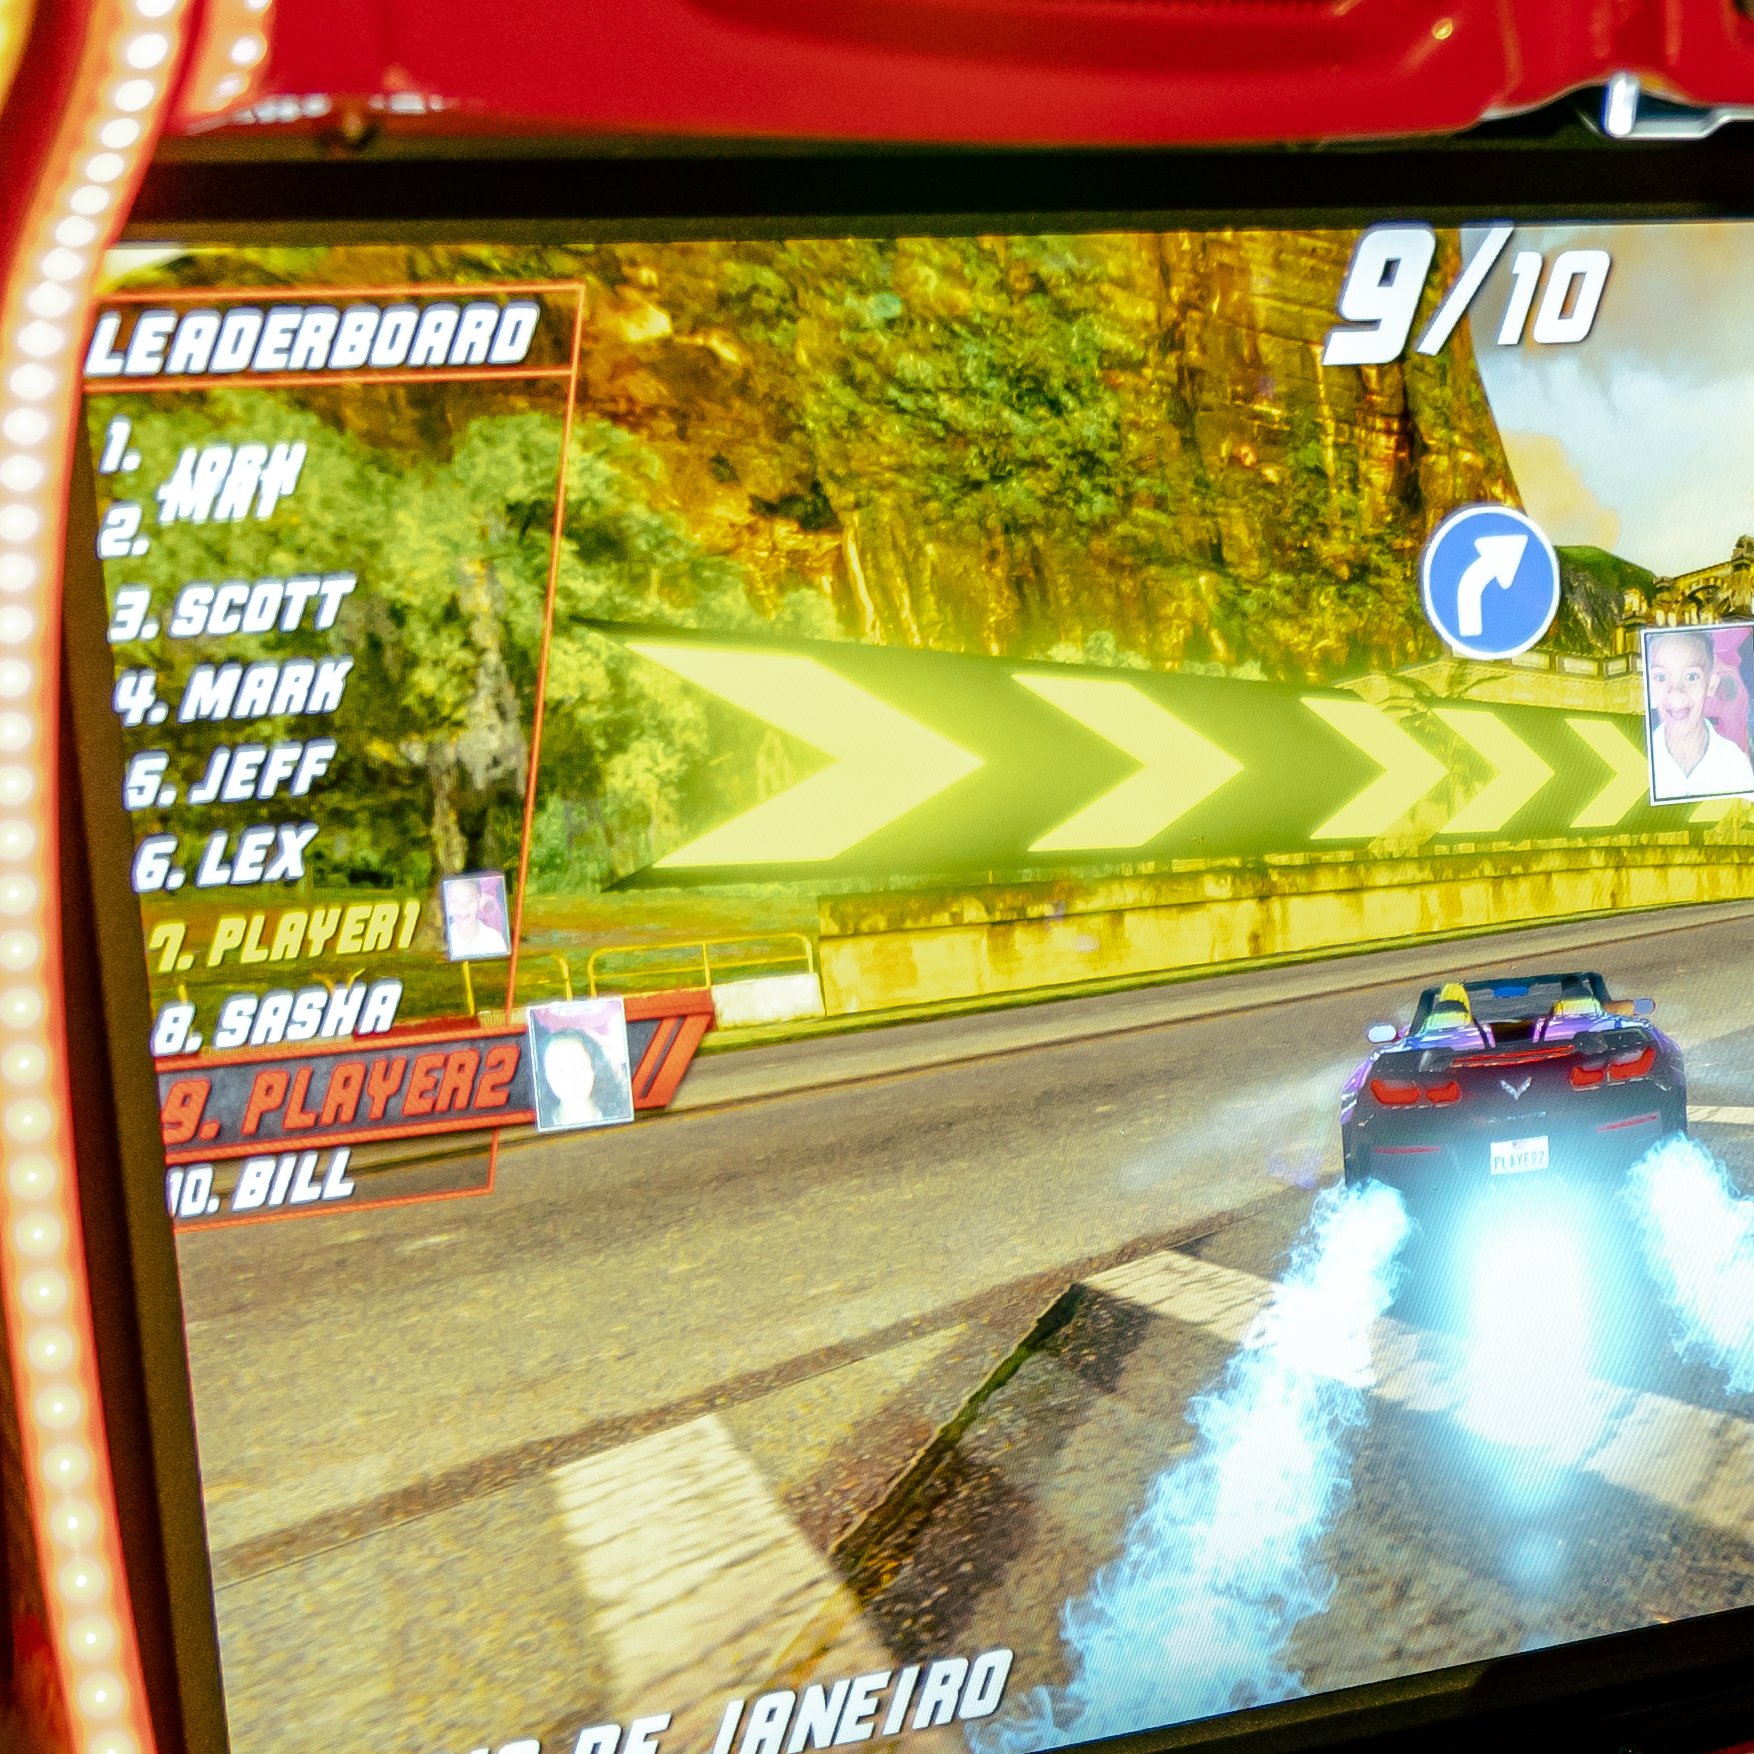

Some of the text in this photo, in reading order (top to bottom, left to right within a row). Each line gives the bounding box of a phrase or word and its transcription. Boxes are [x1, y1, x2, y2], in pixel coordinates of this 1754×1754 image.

[1322, 220, 1612, 366] 9/10
[85, 302, 541, 378] LEADERBOARD
[100, 415, 140, 474] 1.
[97, 502, 150, 560] 2.
[107, 572, 357, 643] 3. SCOTT
[115, 656, 355, 727] 4. MARK
[125, 740, 338, 810] 5. JEFF
[133, 823, 319, 893] 6. LEX
[149, 902, 420, 973] 7. PLAYER1
[152, 980, 404, 1057] 8. SASHA
[161, 1045, 521, 1146] 9. PLAYER2
[231, 1148, 356, 1212] BILL
